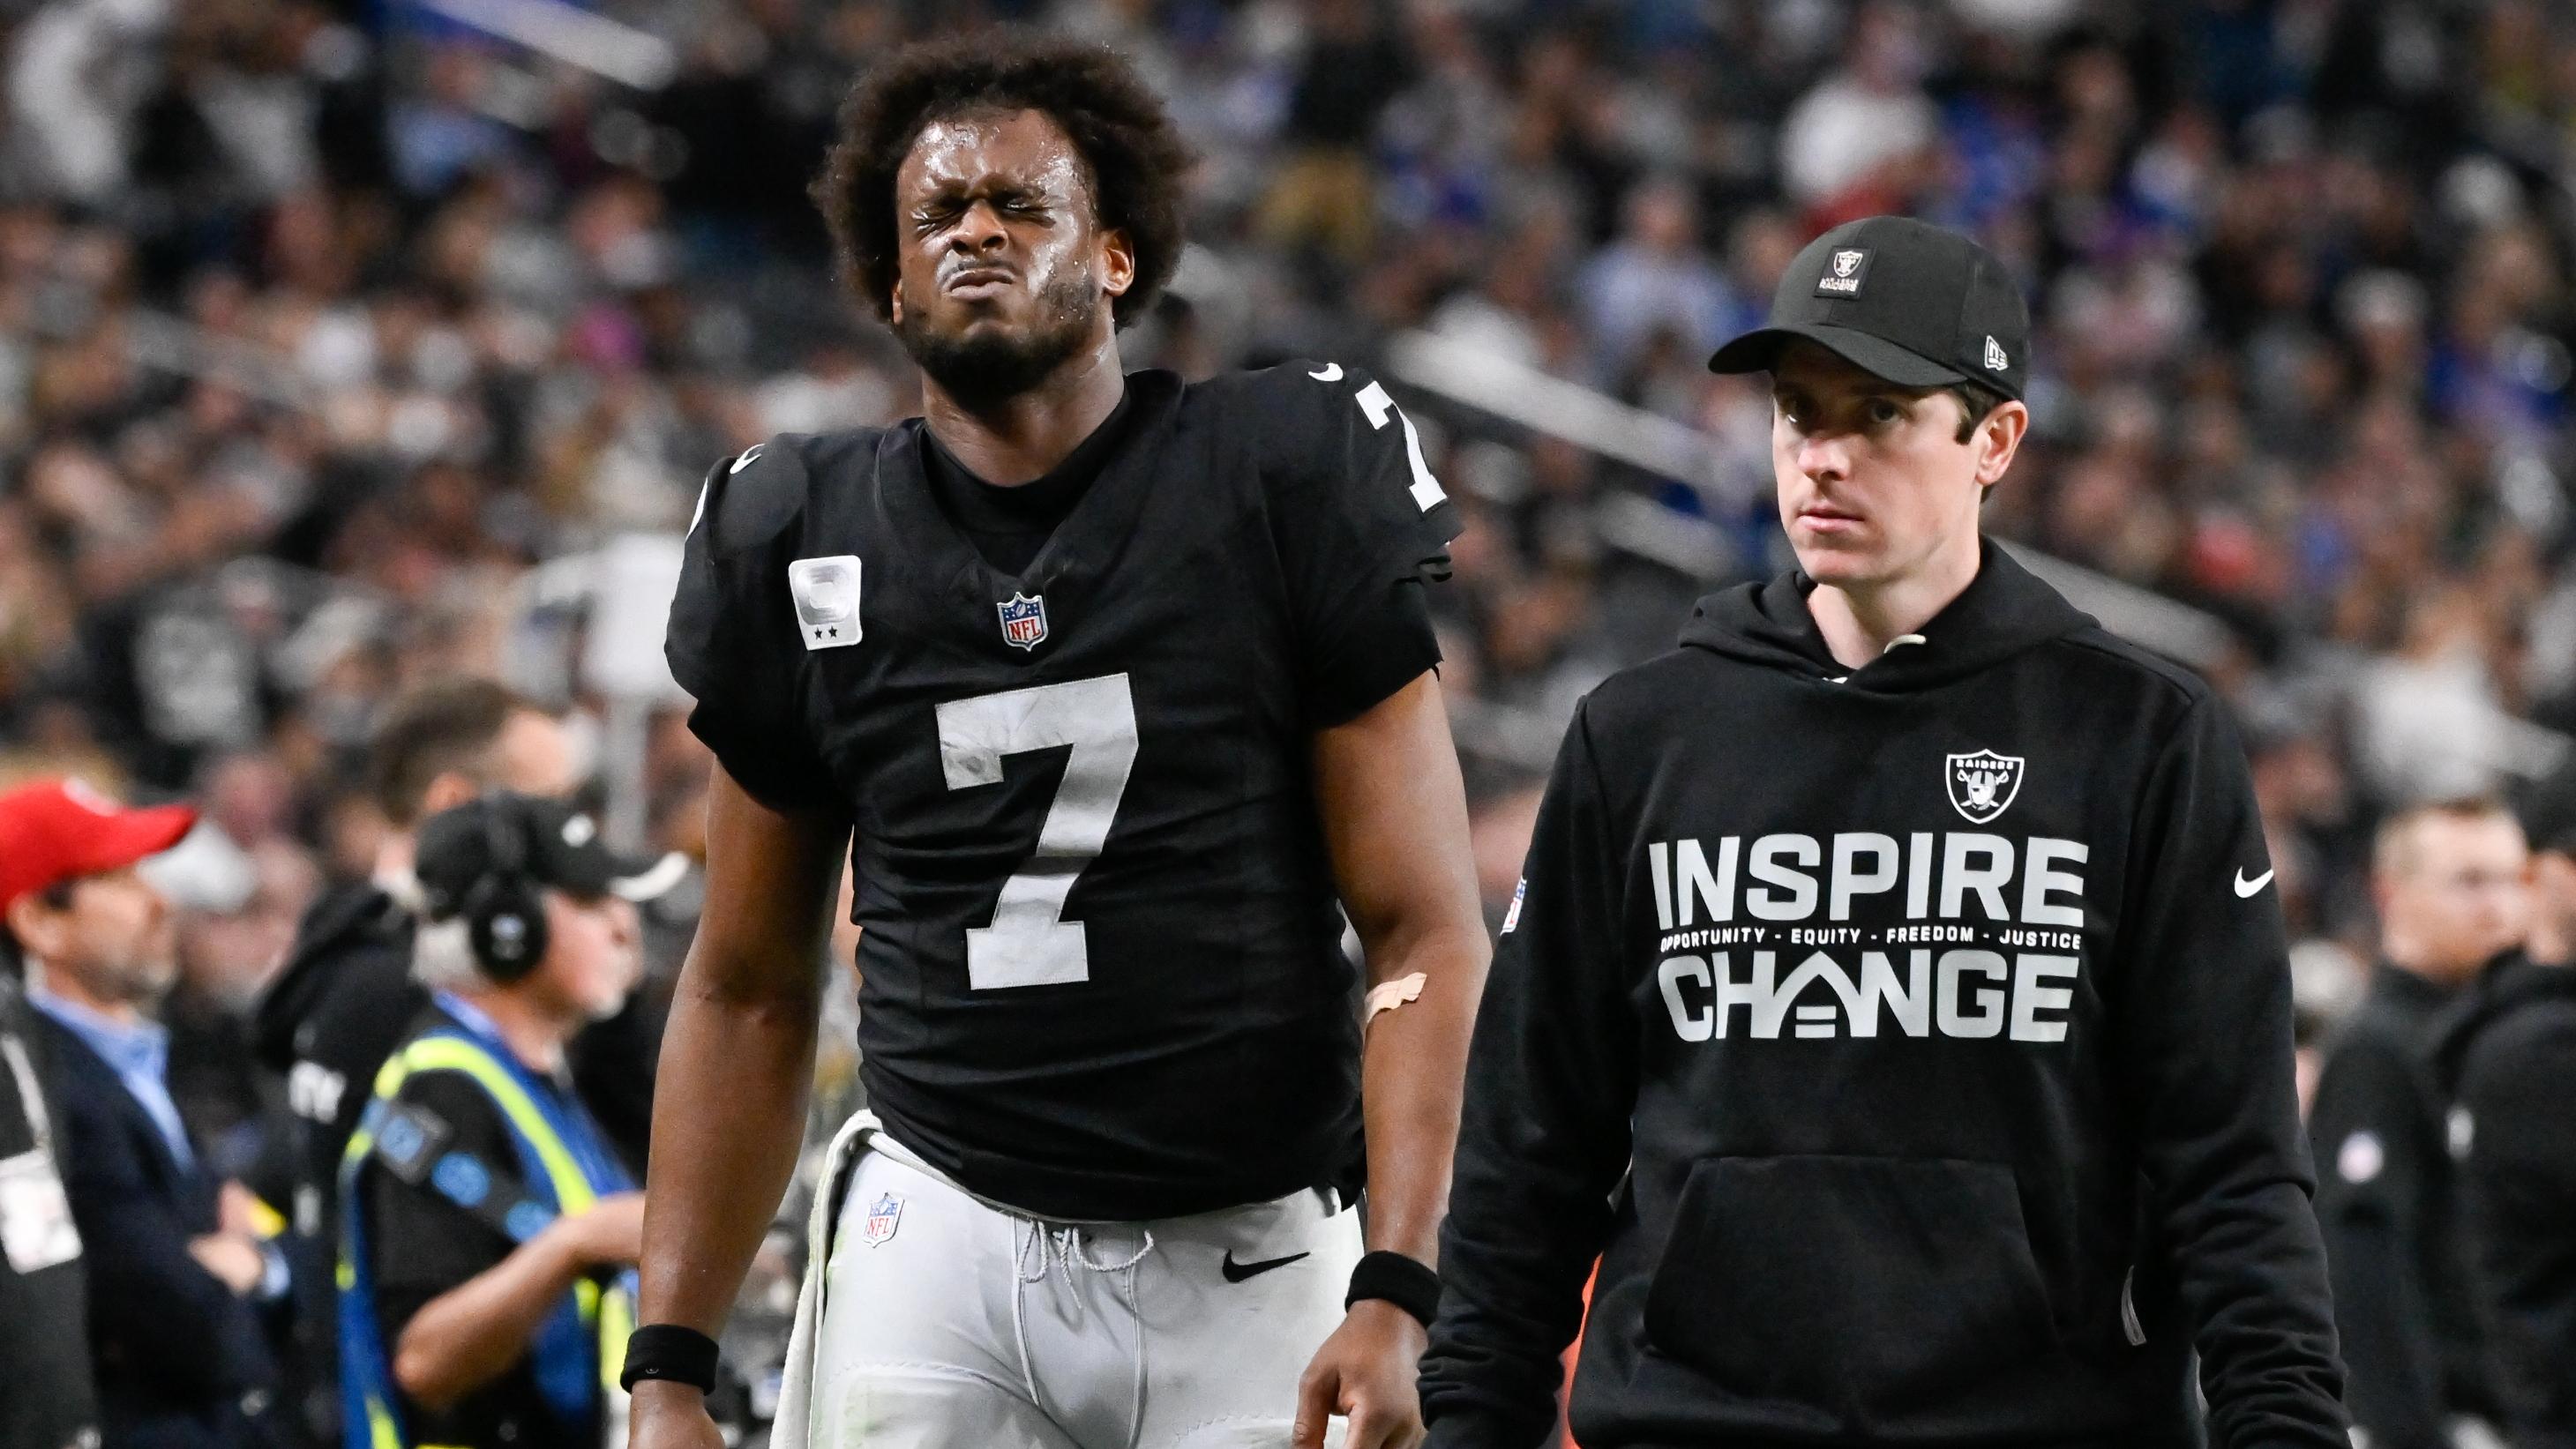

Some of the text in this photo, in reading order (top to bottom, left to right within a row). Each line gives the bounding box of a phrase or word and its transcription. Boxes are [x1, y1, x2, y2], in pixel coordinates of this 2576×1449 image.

[1355, 380, 1448, 512] 7
[1008, 619, 1041, 640] NFL
[1956, 758, 2014, 770] RAIDERS
[935, 672, 1139, 990] 7
[1649, 832, 2089, 930] INSPIRE
[1660, 927, 1765, 953] OPPORTUNITY
[1791, 928, 1861, 946] EQUITY
[1886, 925, 1974, 945] FREEDOM
[1998, 929, 2082, 951] JUSTICE
[1657, 948, 2079, 1042] CHANGE
[866, 1217, 891, 1236] NFL
